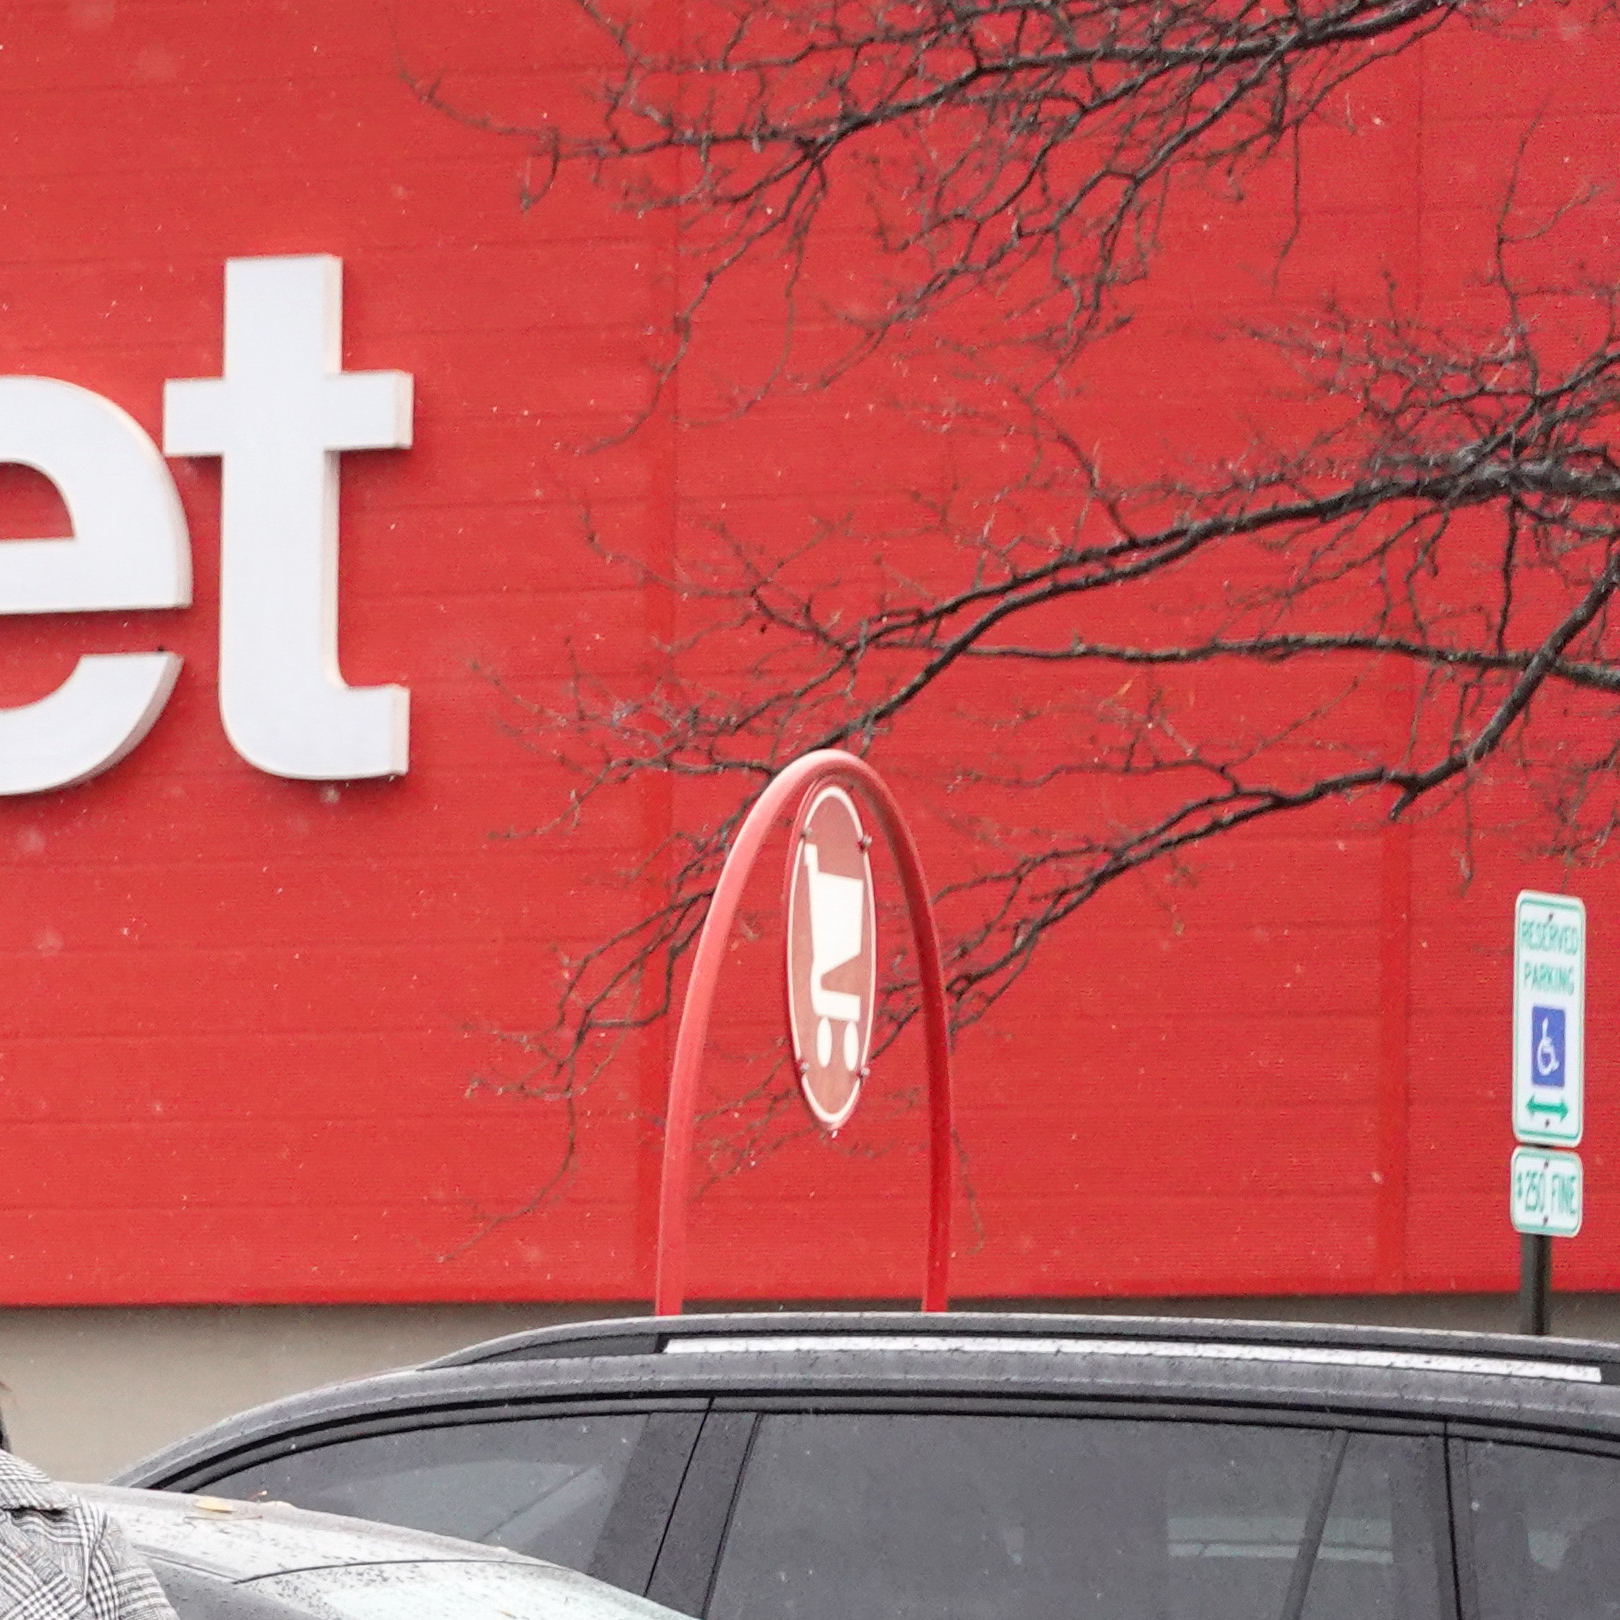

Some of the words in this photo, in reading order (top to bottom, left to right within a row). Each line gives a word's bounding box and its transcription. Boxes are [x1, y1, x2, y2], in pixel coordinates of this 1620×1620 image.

[1521, 920, 1579, 956] RESERVED
[1523, 961, 1575, 996] PARKING
[1551, 1174, 1577, 1215] FINE
